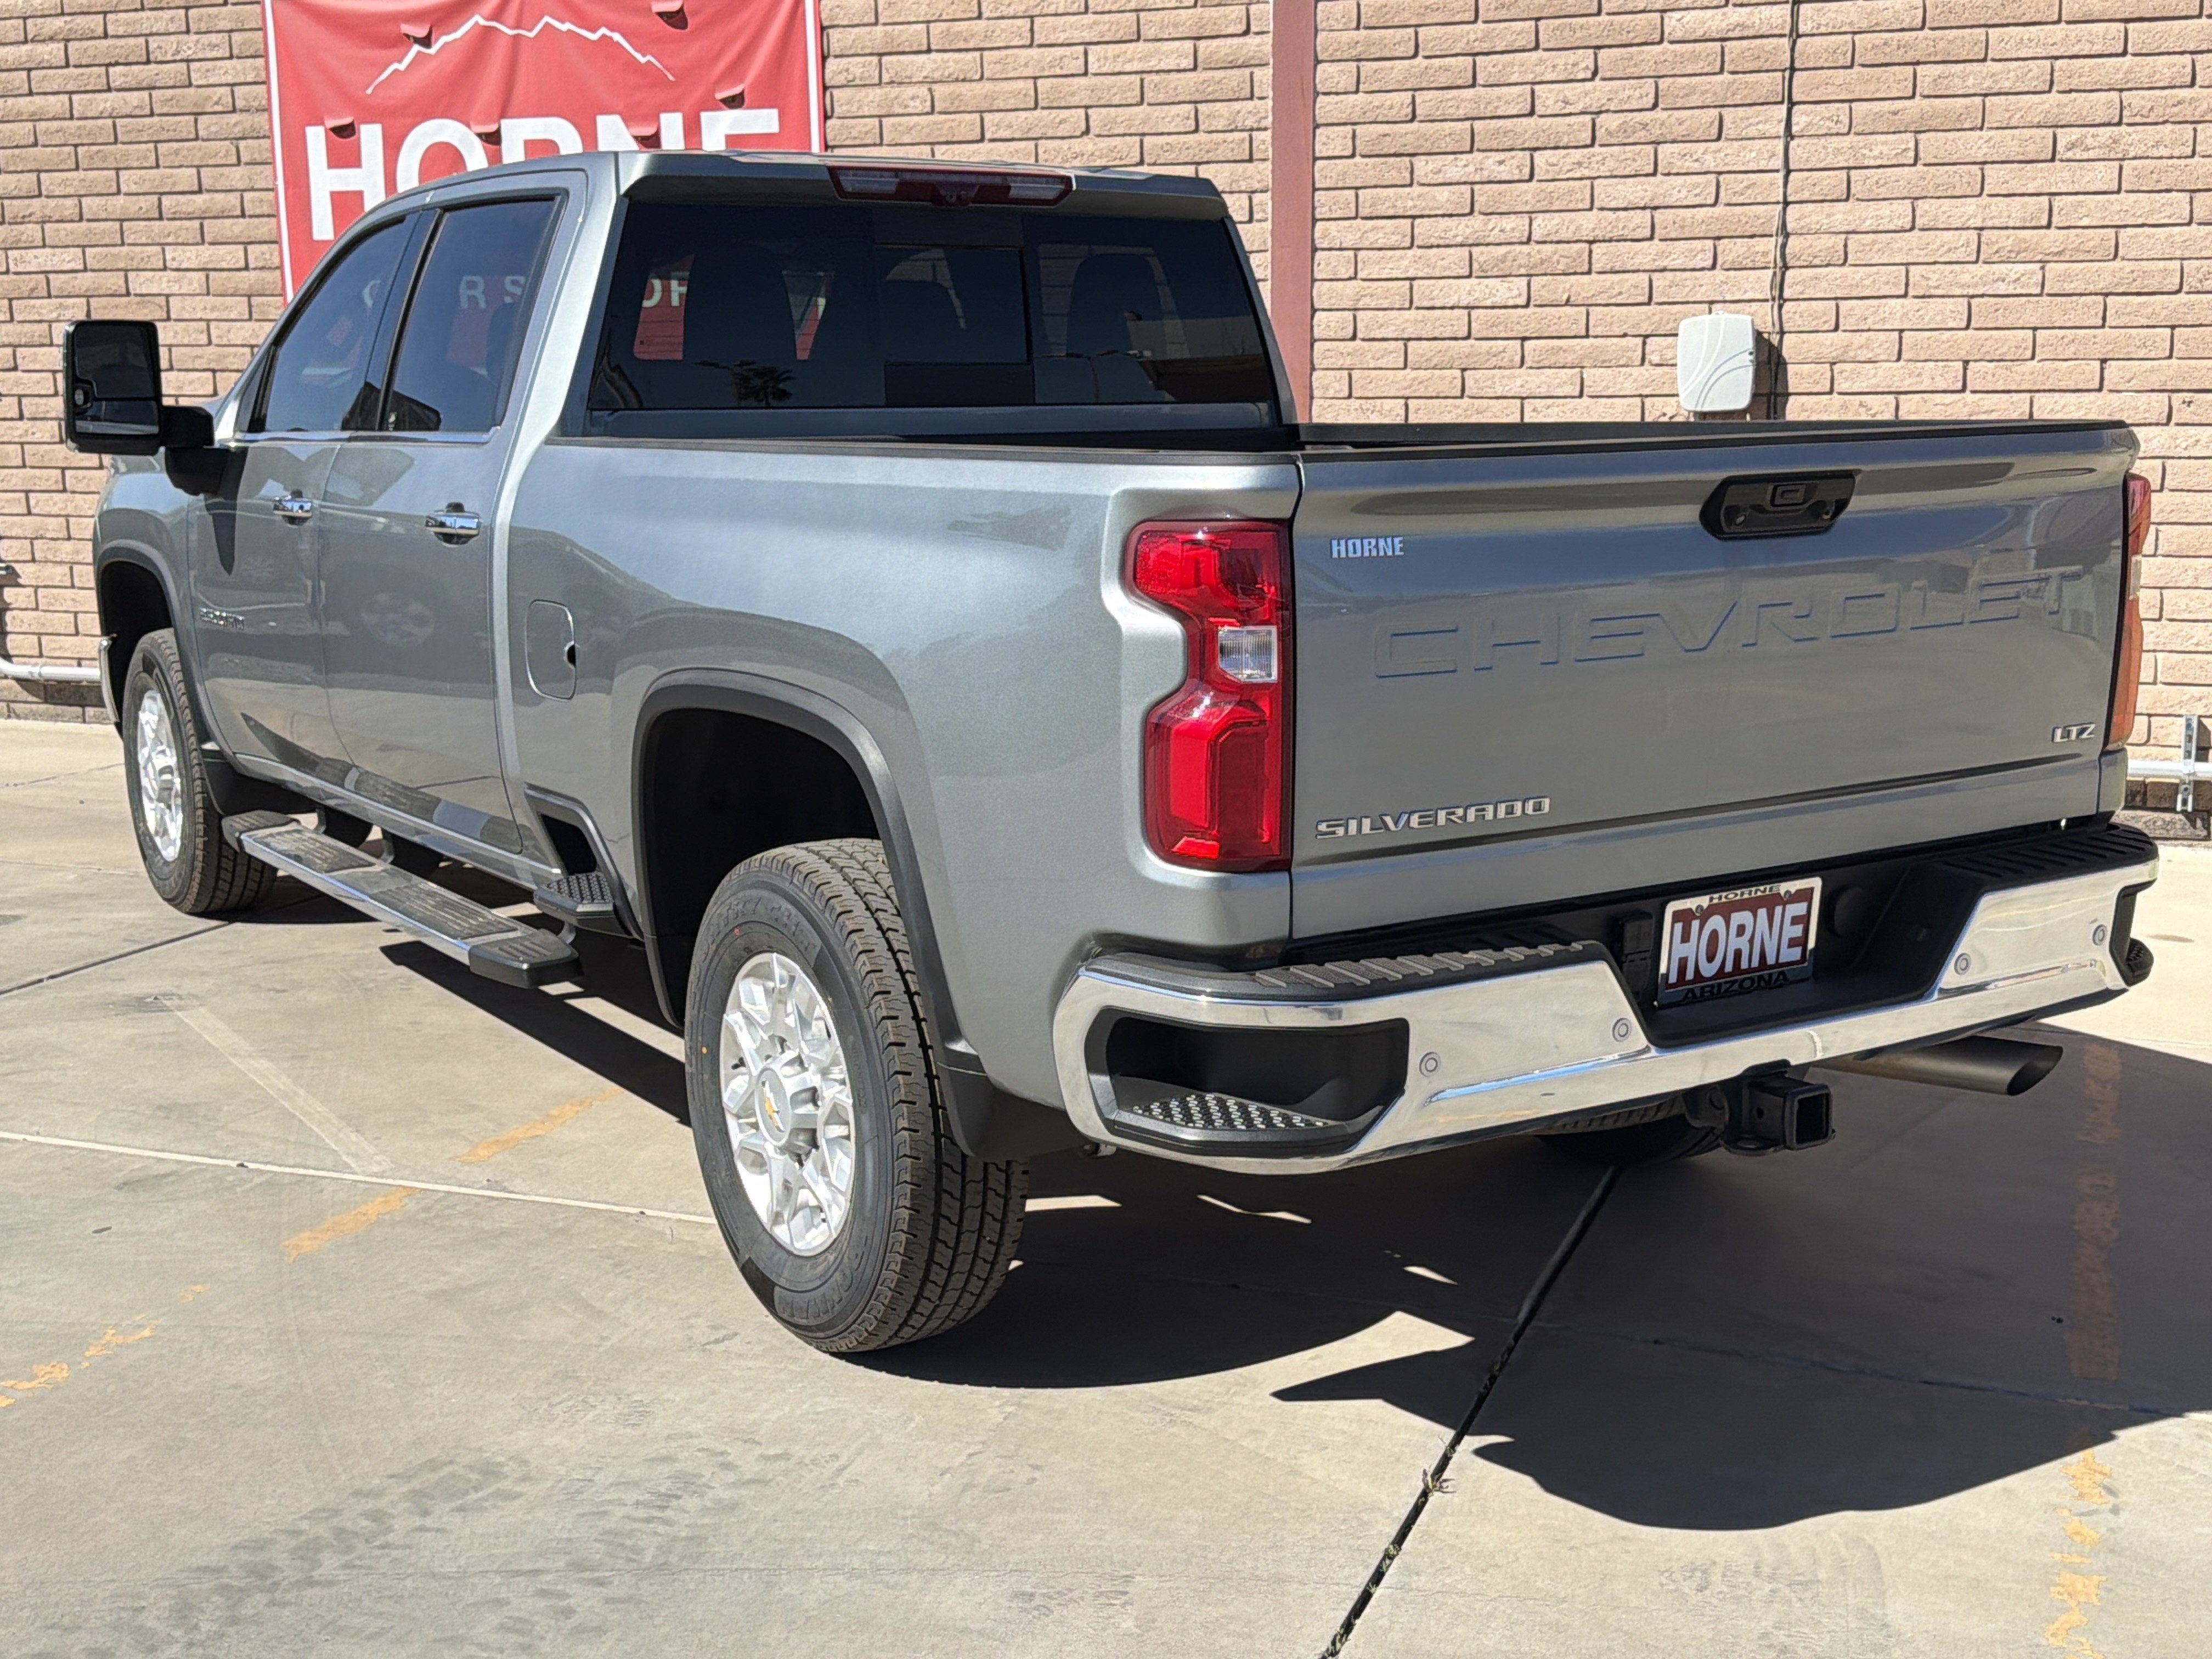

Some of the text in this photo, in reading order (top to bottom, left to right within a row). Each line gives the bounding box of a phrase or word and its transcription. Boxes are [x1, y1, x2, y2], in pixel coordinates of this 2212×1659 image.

[1330, 536, 1404, 558] HORNE
[1374, 565, 2083, 679] CHEVROLET
[2052, 722, 2096, 744] LTZ
[1316, 795, 1551, 839] SILVERADO
[1709, 884, 1781, 903] HORNE
[1667, 901, 1808, 984] HORNE
[1683, 971, 1789, 1001] ARIZONA
